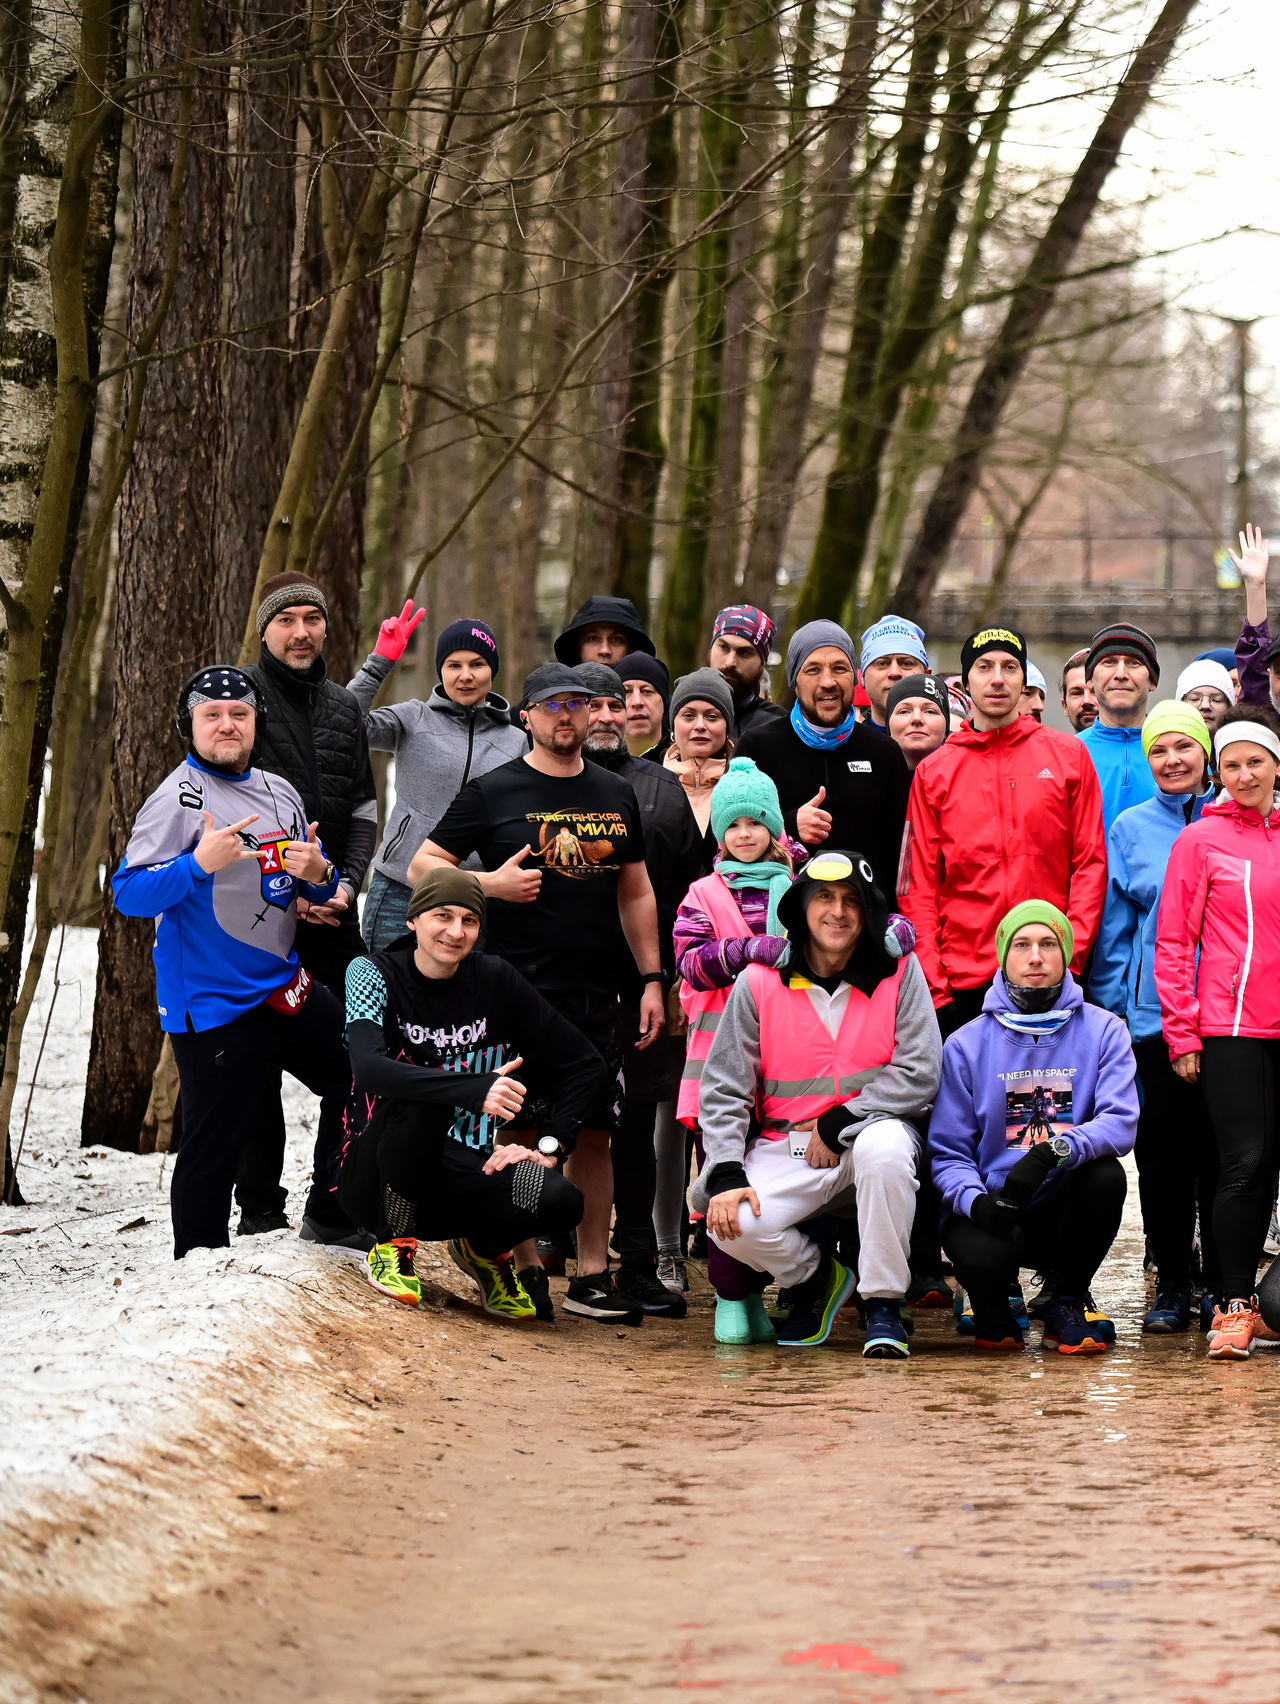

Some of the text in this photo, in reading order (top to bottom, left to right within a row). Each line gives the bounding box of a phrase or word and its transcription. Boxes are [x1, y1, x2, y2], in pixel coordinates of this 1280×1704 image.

[471, 627, 496, 652] ROXY
[527, 812, 623, 822] СПАРТАНСКАЯ
[576, 822, 628, 837] МИЛЯ
[436, 1044, 474, 1056] ЗАБЕГ
[1007, 1069, 1032, 1081] NEED
[1033, 1068, 1045, 1078] MY
